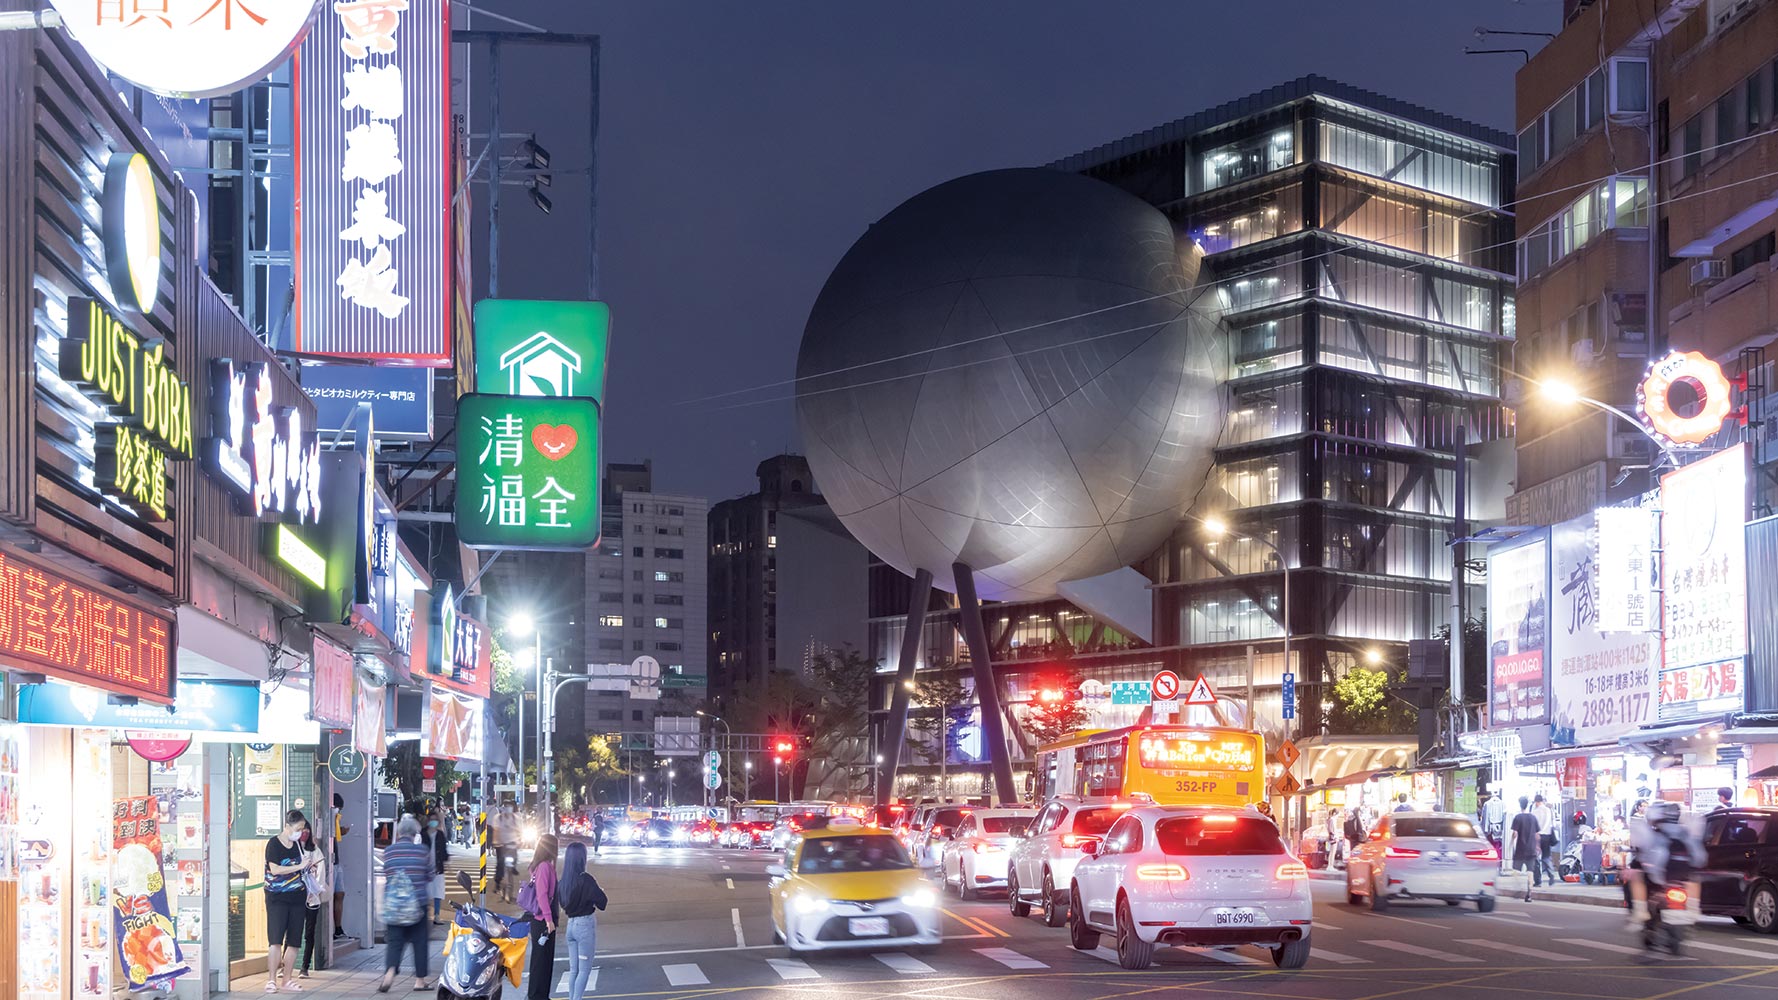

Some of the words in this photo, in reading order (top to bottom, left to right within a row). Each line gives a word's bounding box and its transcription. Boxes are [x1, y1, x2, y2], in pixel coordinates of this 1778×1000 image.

[82, 301, 138, 415] JUST
[302, 387, 416, 401] とタピオカミルクティー専門店
[479, 473, 576, 528] 福全
[0, 554, 166, 690] 奶蓋系列新品上市
[1658, 663, 1737, 704] 大腸包小腸
[1581, 692, 1650, 728] 2889-1177
[1175, 781, 1217, 792] 352-FP
[116, 894, 152, 917] VS
[124, 912, 160, 932] FIGHT
